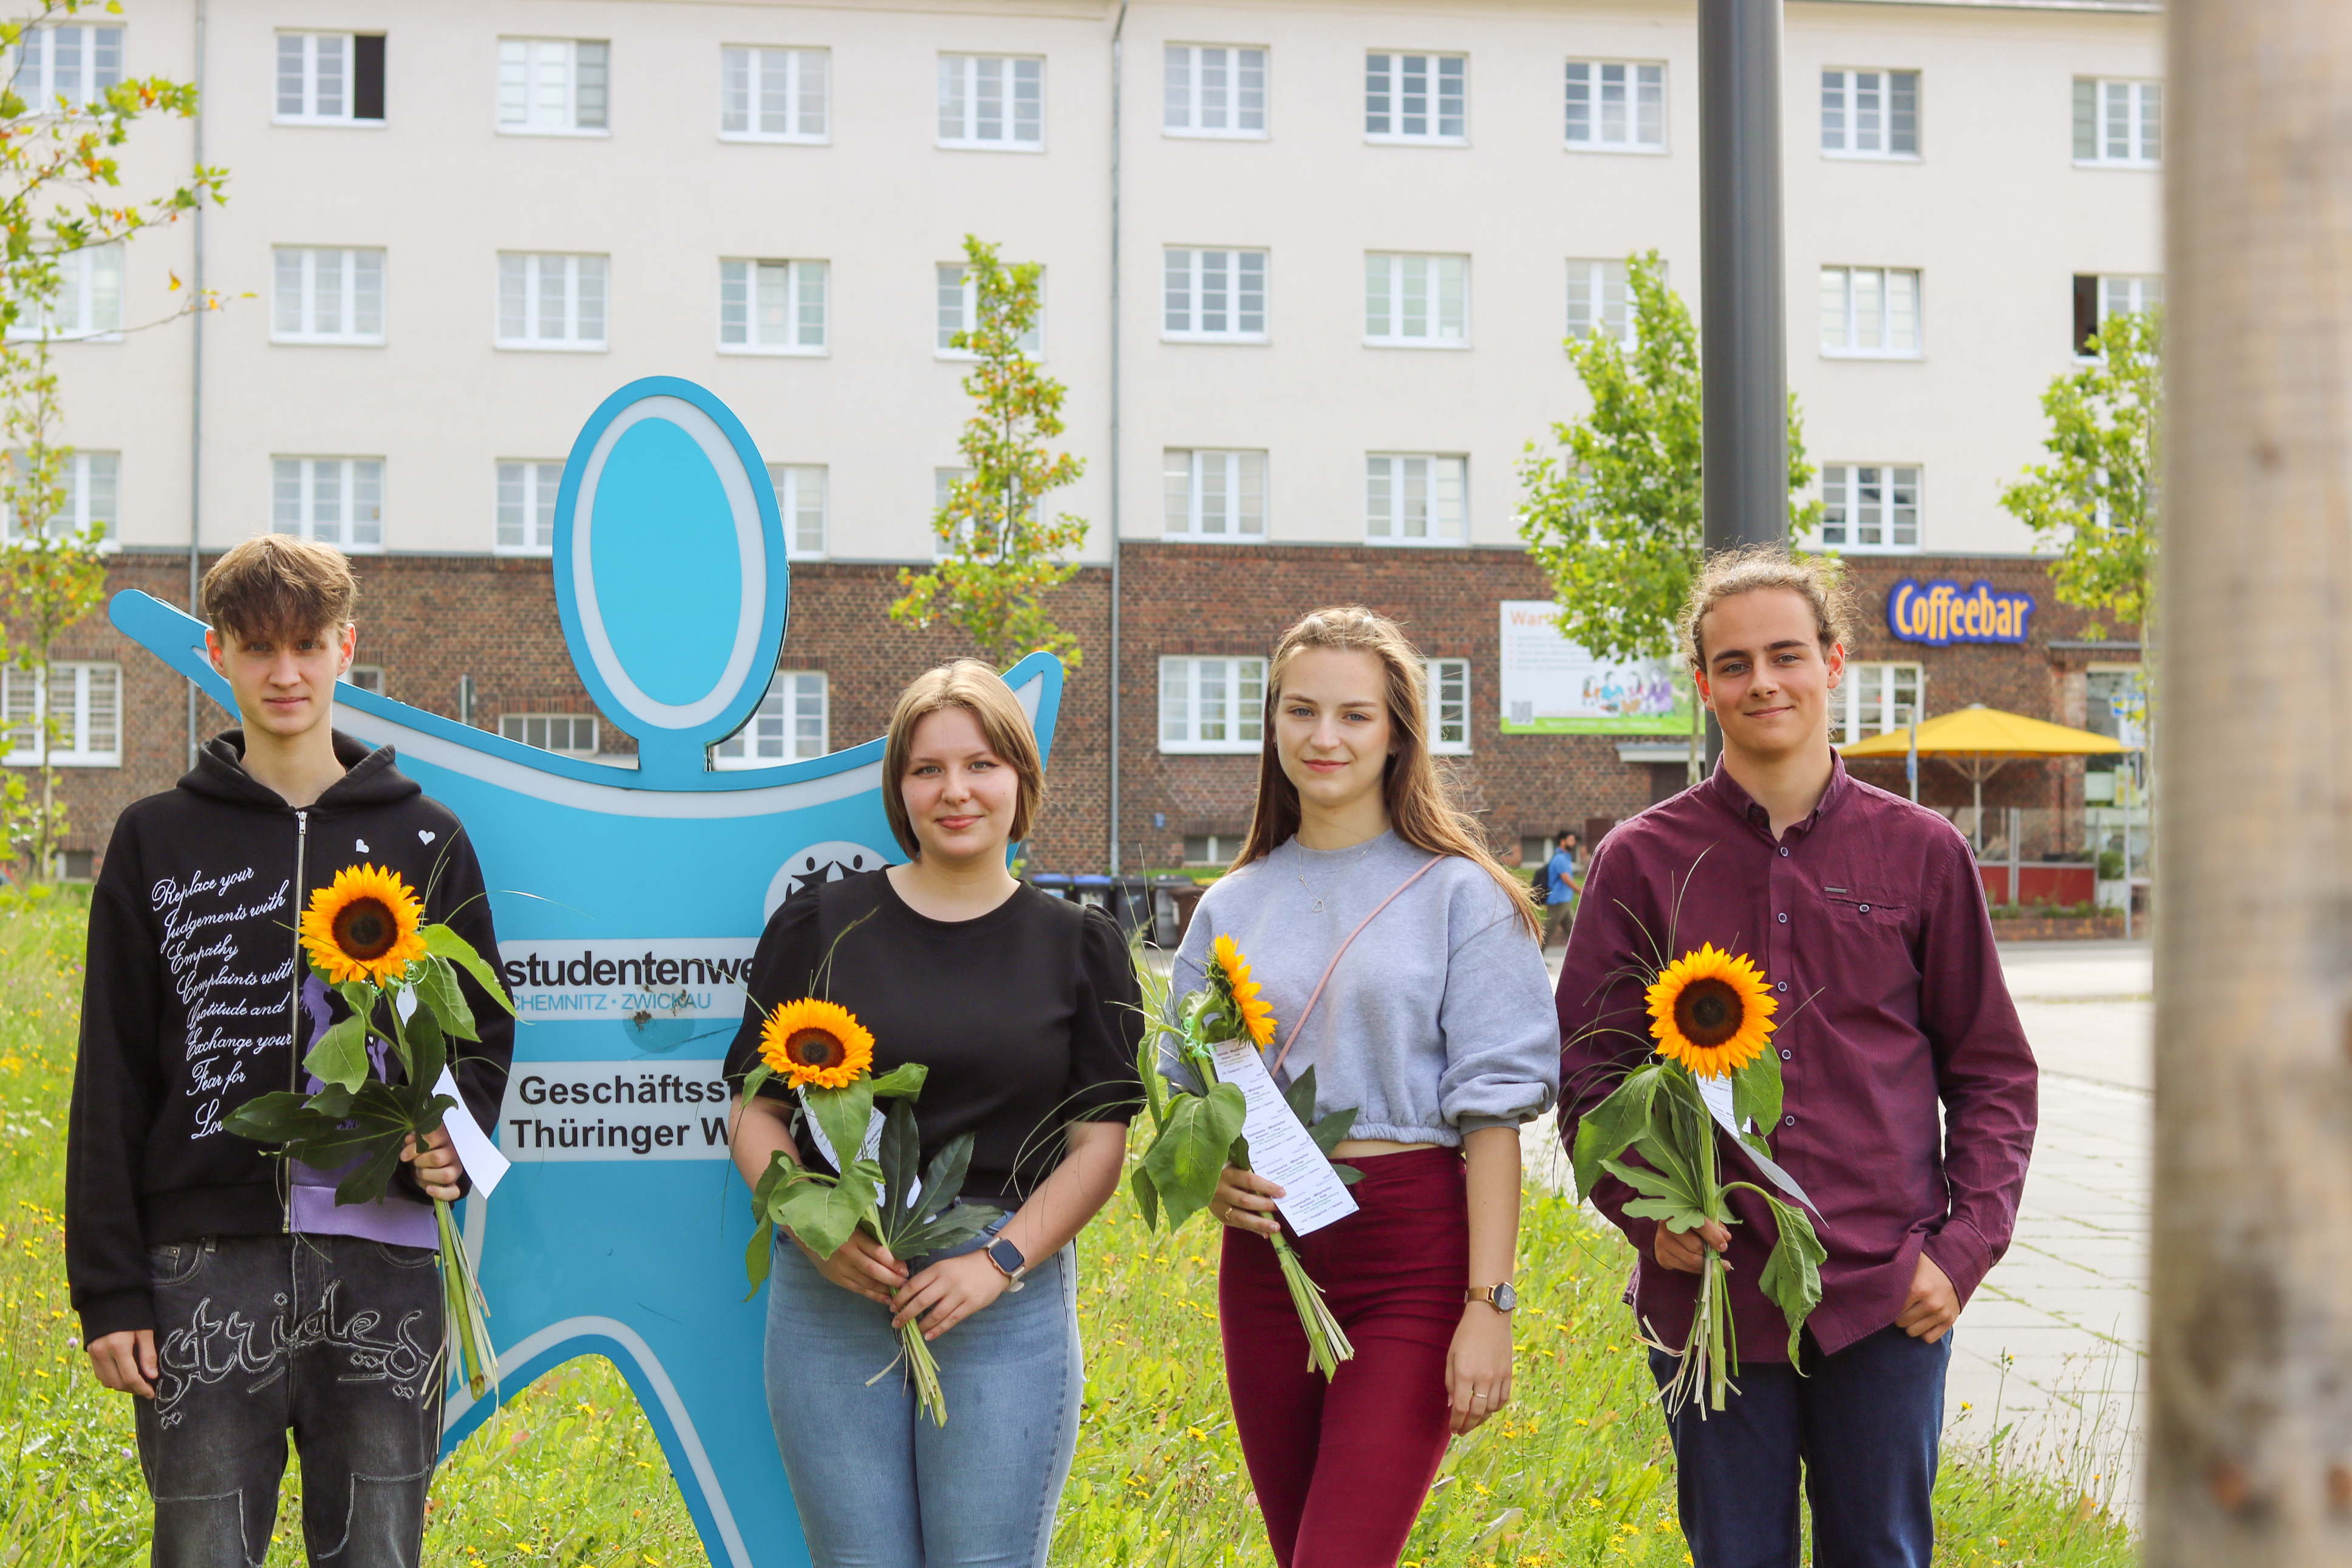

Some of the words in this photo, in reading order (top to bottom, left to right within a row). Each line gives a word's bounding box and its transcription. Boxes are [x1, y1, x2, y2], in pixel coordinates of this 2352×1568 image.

[1895, 585, 2029, 639] Coffeebar
[152, 870, 217, 911] Replace
[218, 867, 254, 896] your
[160, 904, 247, 953] Judgements
[249, 879, 289, 917] with
[167, 934, 239, 974] Empathy
[177, 966, 257, 1004] Complaints
[250, 991, 291, 1015] and
[621, 993, 711, 1010] ZWICKAU
[185, 1026, 253, 1061] Exchange
[253, 1033, 292, 1055] your
[186, 1055, 223, 1096] Fear
[222, 1060, 246, 1095] for
[520, 1074, 731, 1105] Geschäftss
[510, 1119, 690, 1154] Thüringer
[155, 1278, 430, 1414] strides
